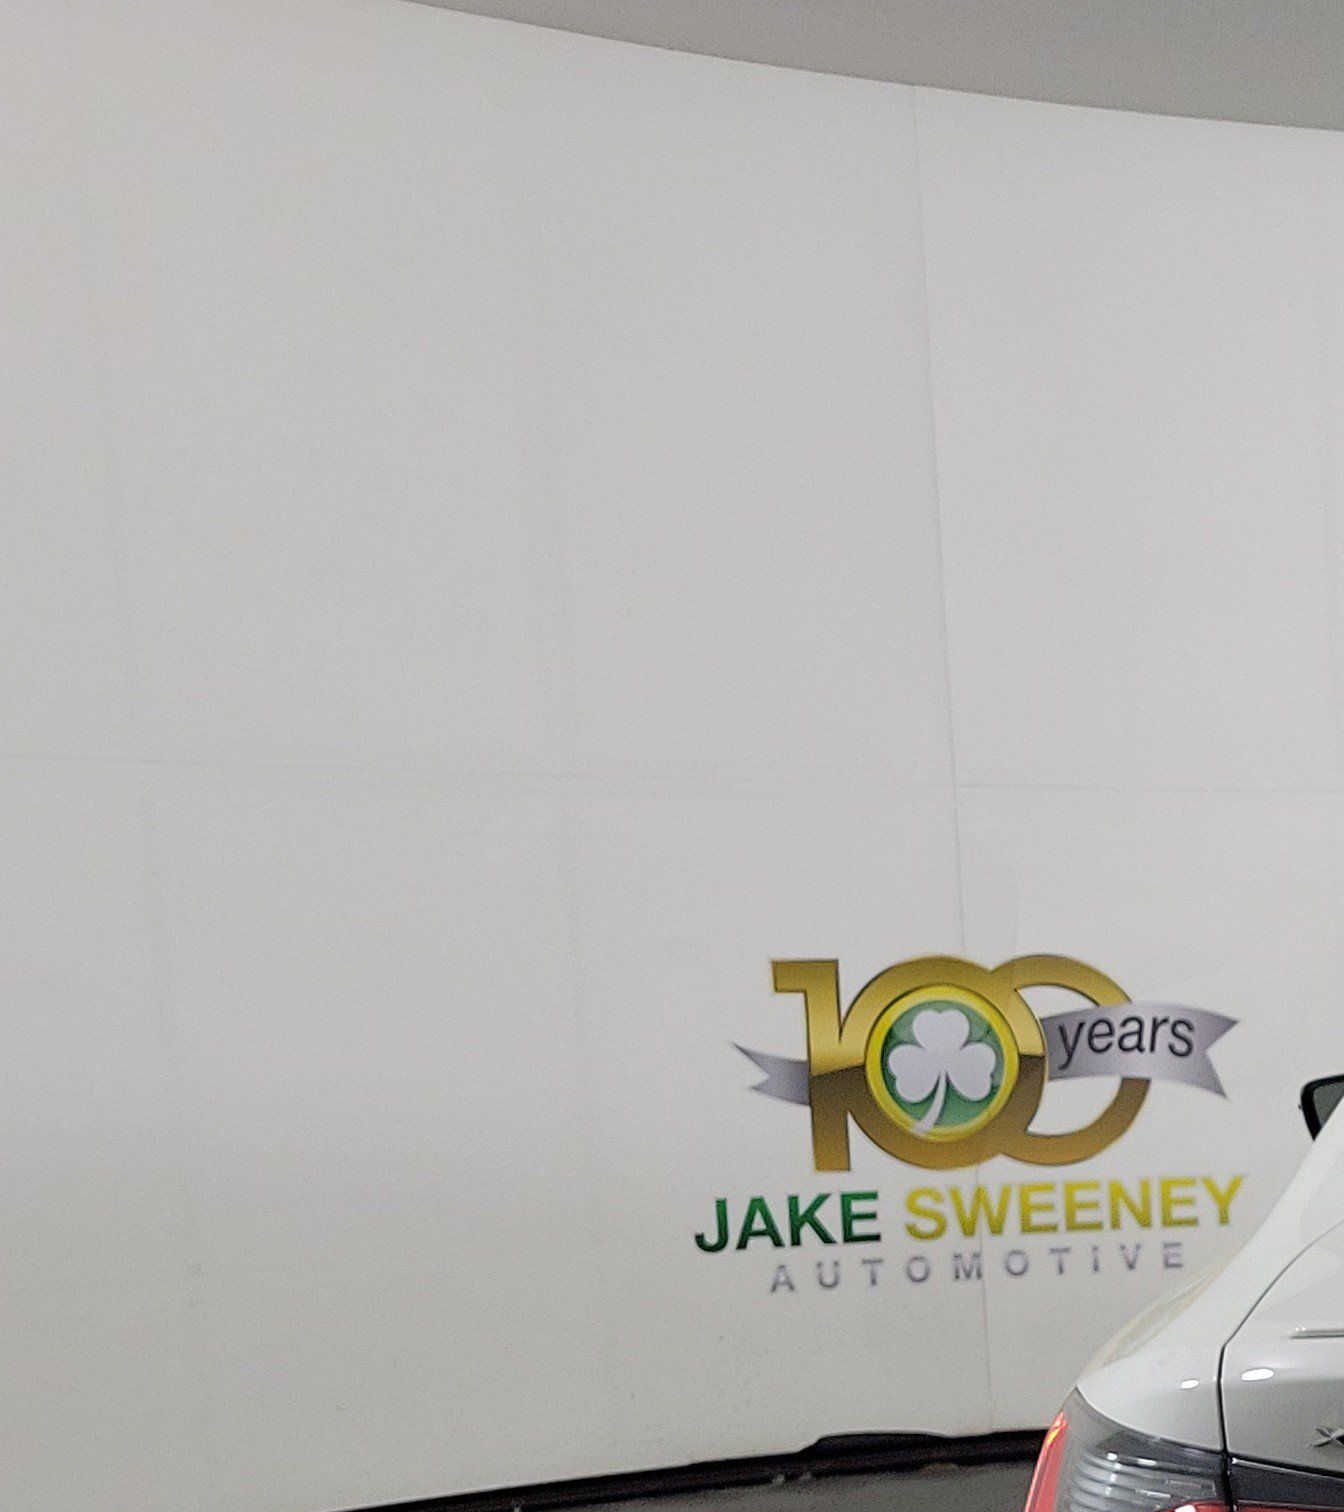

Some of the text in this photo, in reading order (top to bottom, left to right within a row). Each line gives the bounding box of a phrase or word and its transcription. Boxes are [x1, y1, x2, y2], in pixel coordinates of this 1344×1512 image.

[1058, 1014, 1196, 1071] years
[694, 1174, 1244, 1254] JAKE SWEENEY
[770, 1242, 1185, 1294] AUTOMOTIVE
